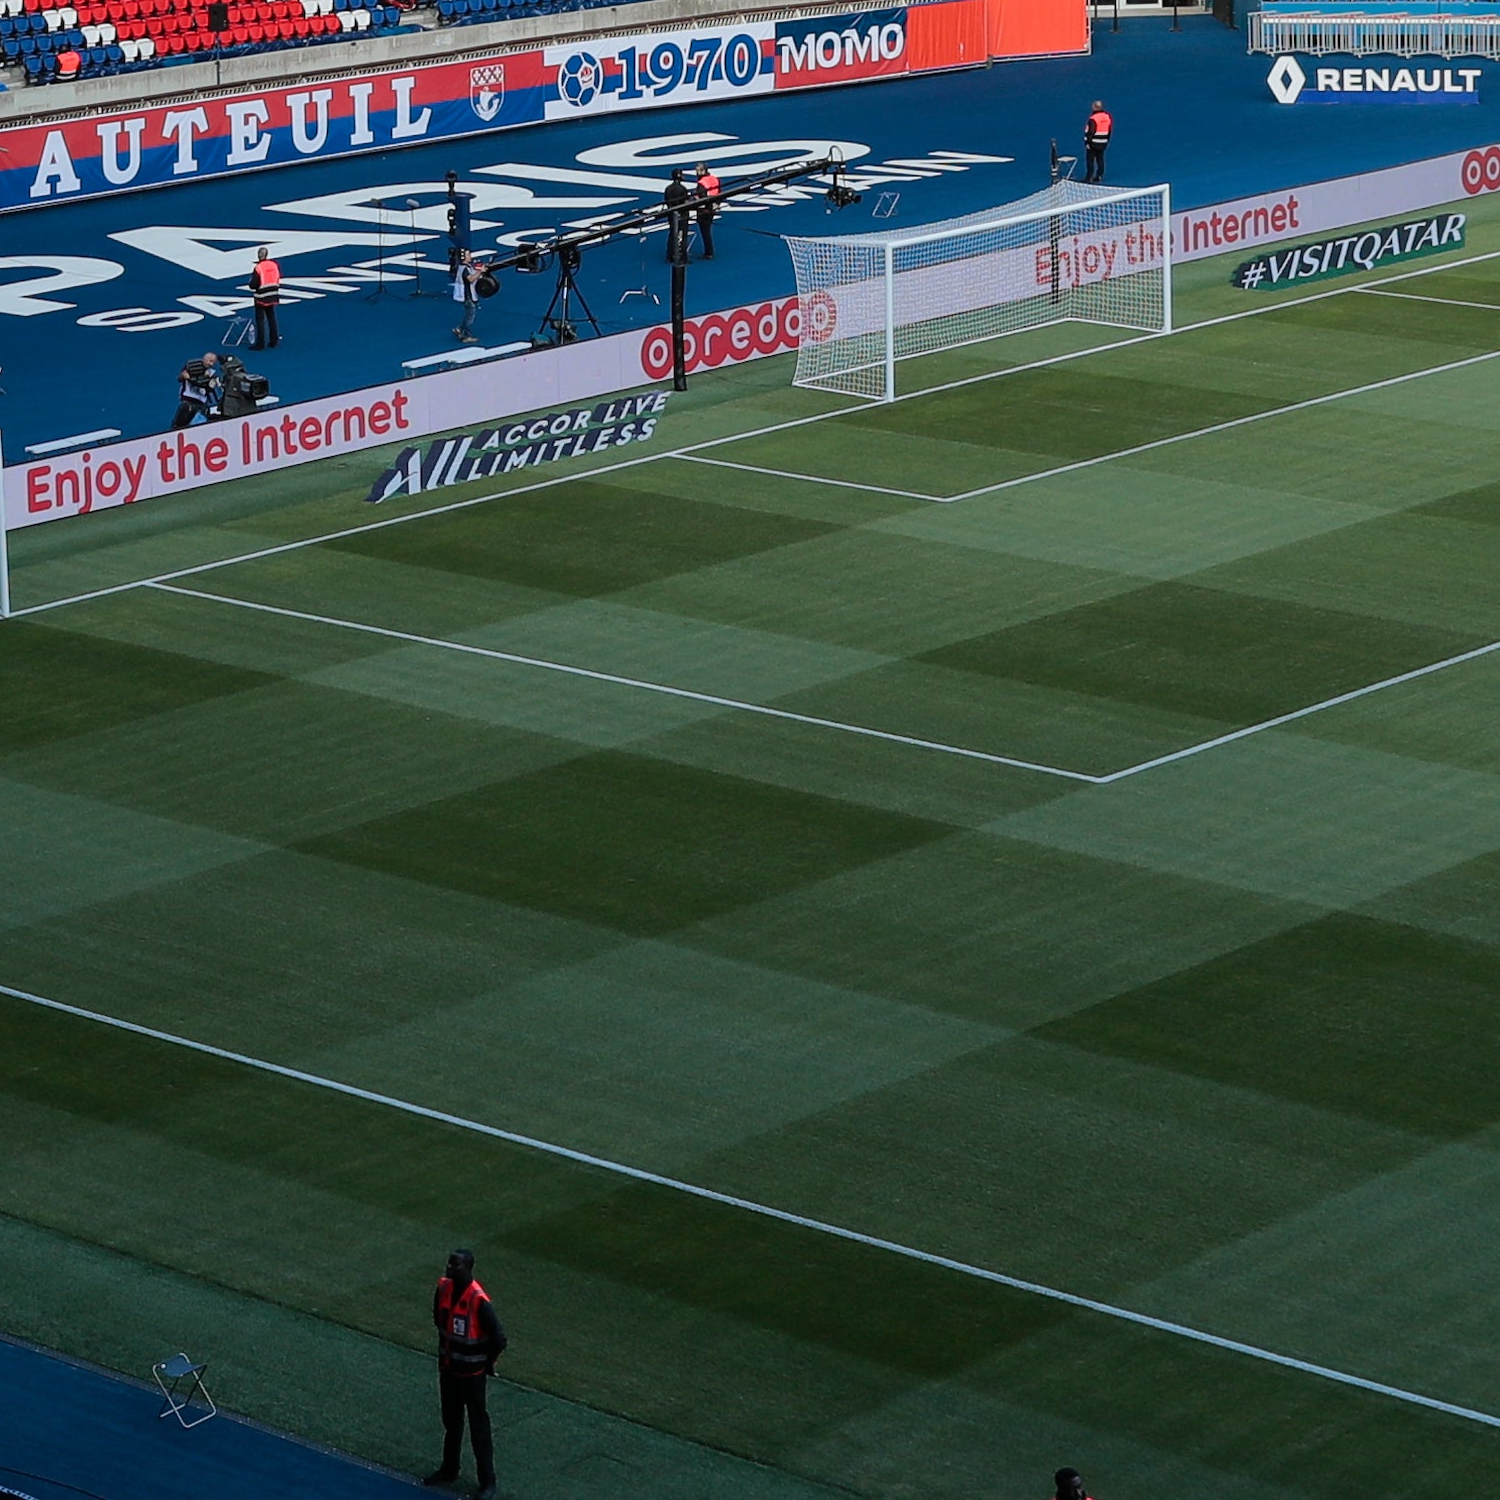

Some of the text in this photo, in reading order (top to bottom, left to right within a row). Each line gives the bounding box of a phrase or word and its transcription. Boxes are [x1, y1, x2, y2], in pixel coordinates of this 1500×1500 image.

[616, 23, 904, 100] 1970 MOMO
[1317, 68, 1482, 92] RENAULT
[1035, 237, 1117, 288] Enjoy
[1183, 195, 1299, 252] Internet
[1242, 214, 1466, 290] #VISITQATAR
[27, 390, 408, 514] Enjoy the Internet
[467, 418, 656, 481] LIMITLESS
[481, 391, 671, 450] ACCOR LIVE
